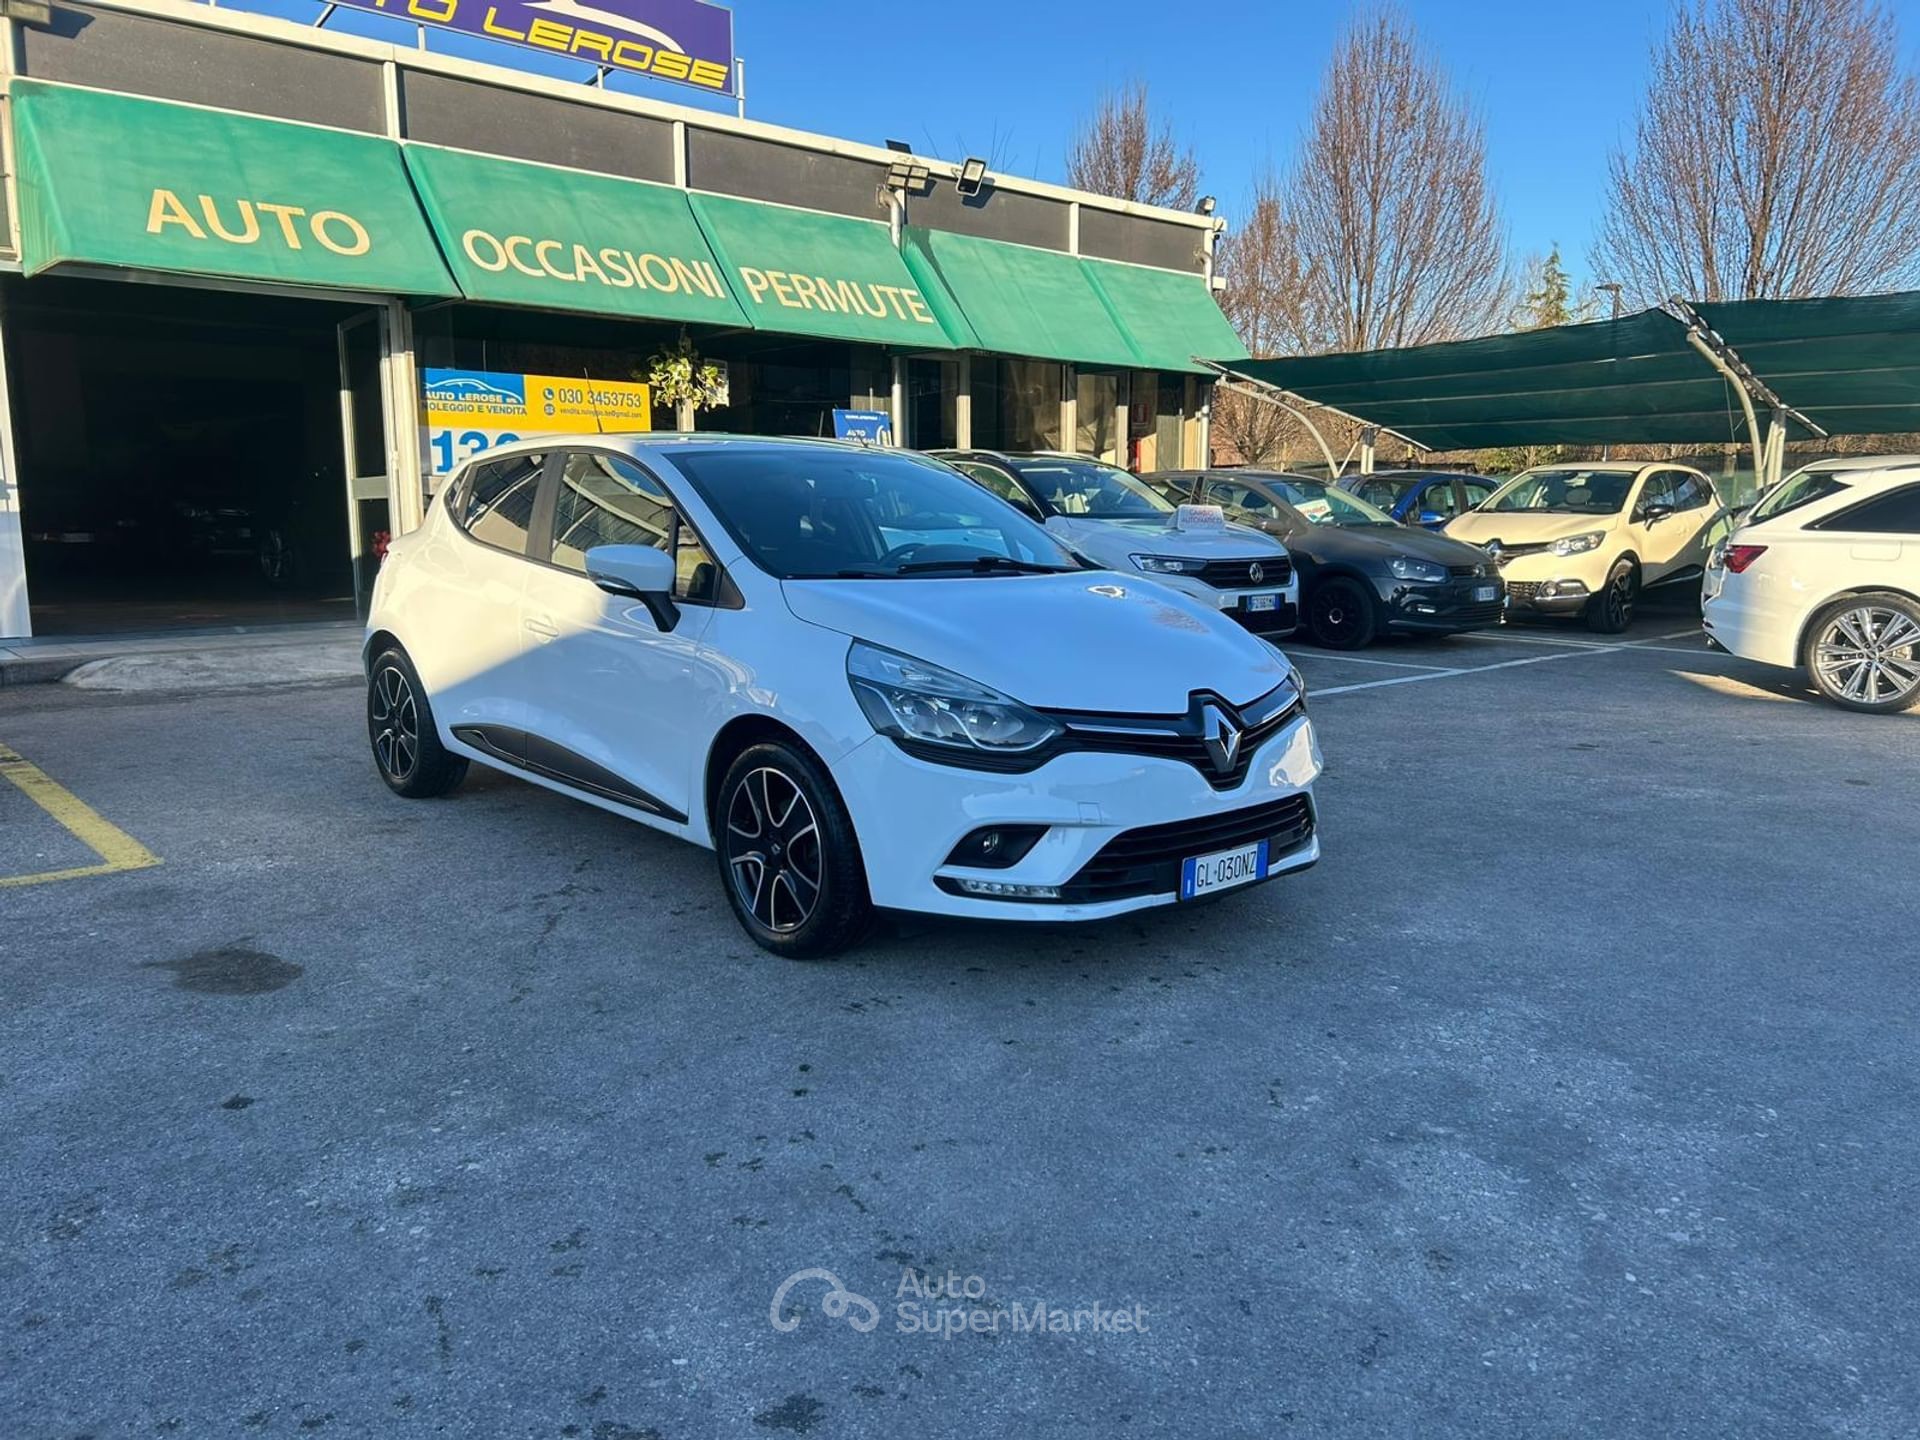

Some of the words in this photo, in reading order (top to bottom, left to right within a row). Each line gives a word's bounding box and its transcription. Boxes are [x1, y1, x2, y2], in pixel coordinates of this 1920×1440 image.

[483, 7, 729, 89] LEROSE
[146, 188, 371, 256] AUTO
[462, 229, 726, 298] OCCASIONI
[738, 266, 935, 323] PERMUTE
[458, 393, 503, 403] LEROSE
[477, 404, 484, 413] E
[487, 405, 527, 416] VENDITA
[558, 388, 583, 404] 030
[587, 390, 642, 408] 3453753
[432, 430, 521, 472] 13
